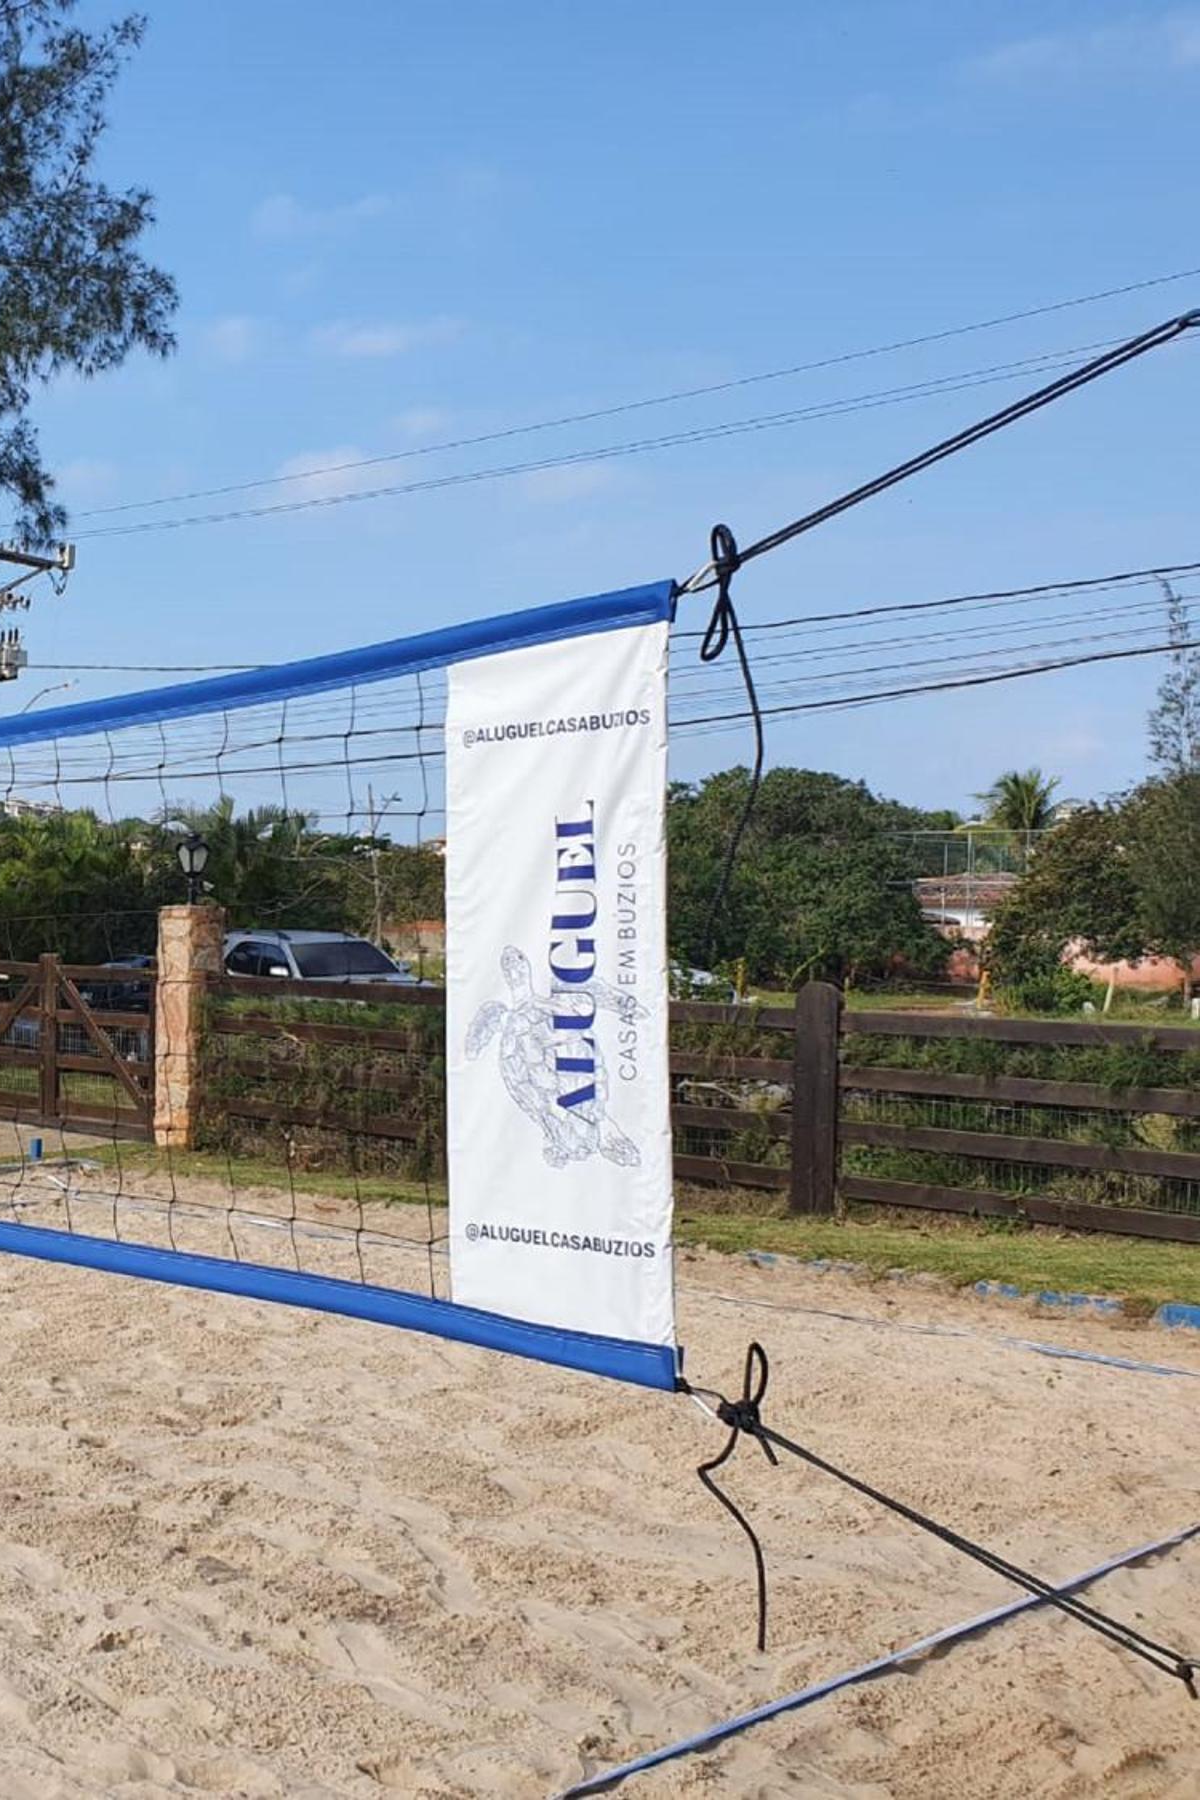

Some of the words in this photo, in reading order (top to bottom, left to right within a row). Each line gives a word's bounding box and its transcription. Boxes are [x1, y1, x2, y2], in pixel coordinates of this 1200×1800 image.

[463, 709, 651, 748] @ALUGUELCASABUZIOS
[549, 799, 598, 1126] ALUGUEL
[617, 949, 637, 985] EM
[617, 994, 638, 1081] CASAS
[465, 1222, 657, 1259] @ALUGUELCASABUZIOS
